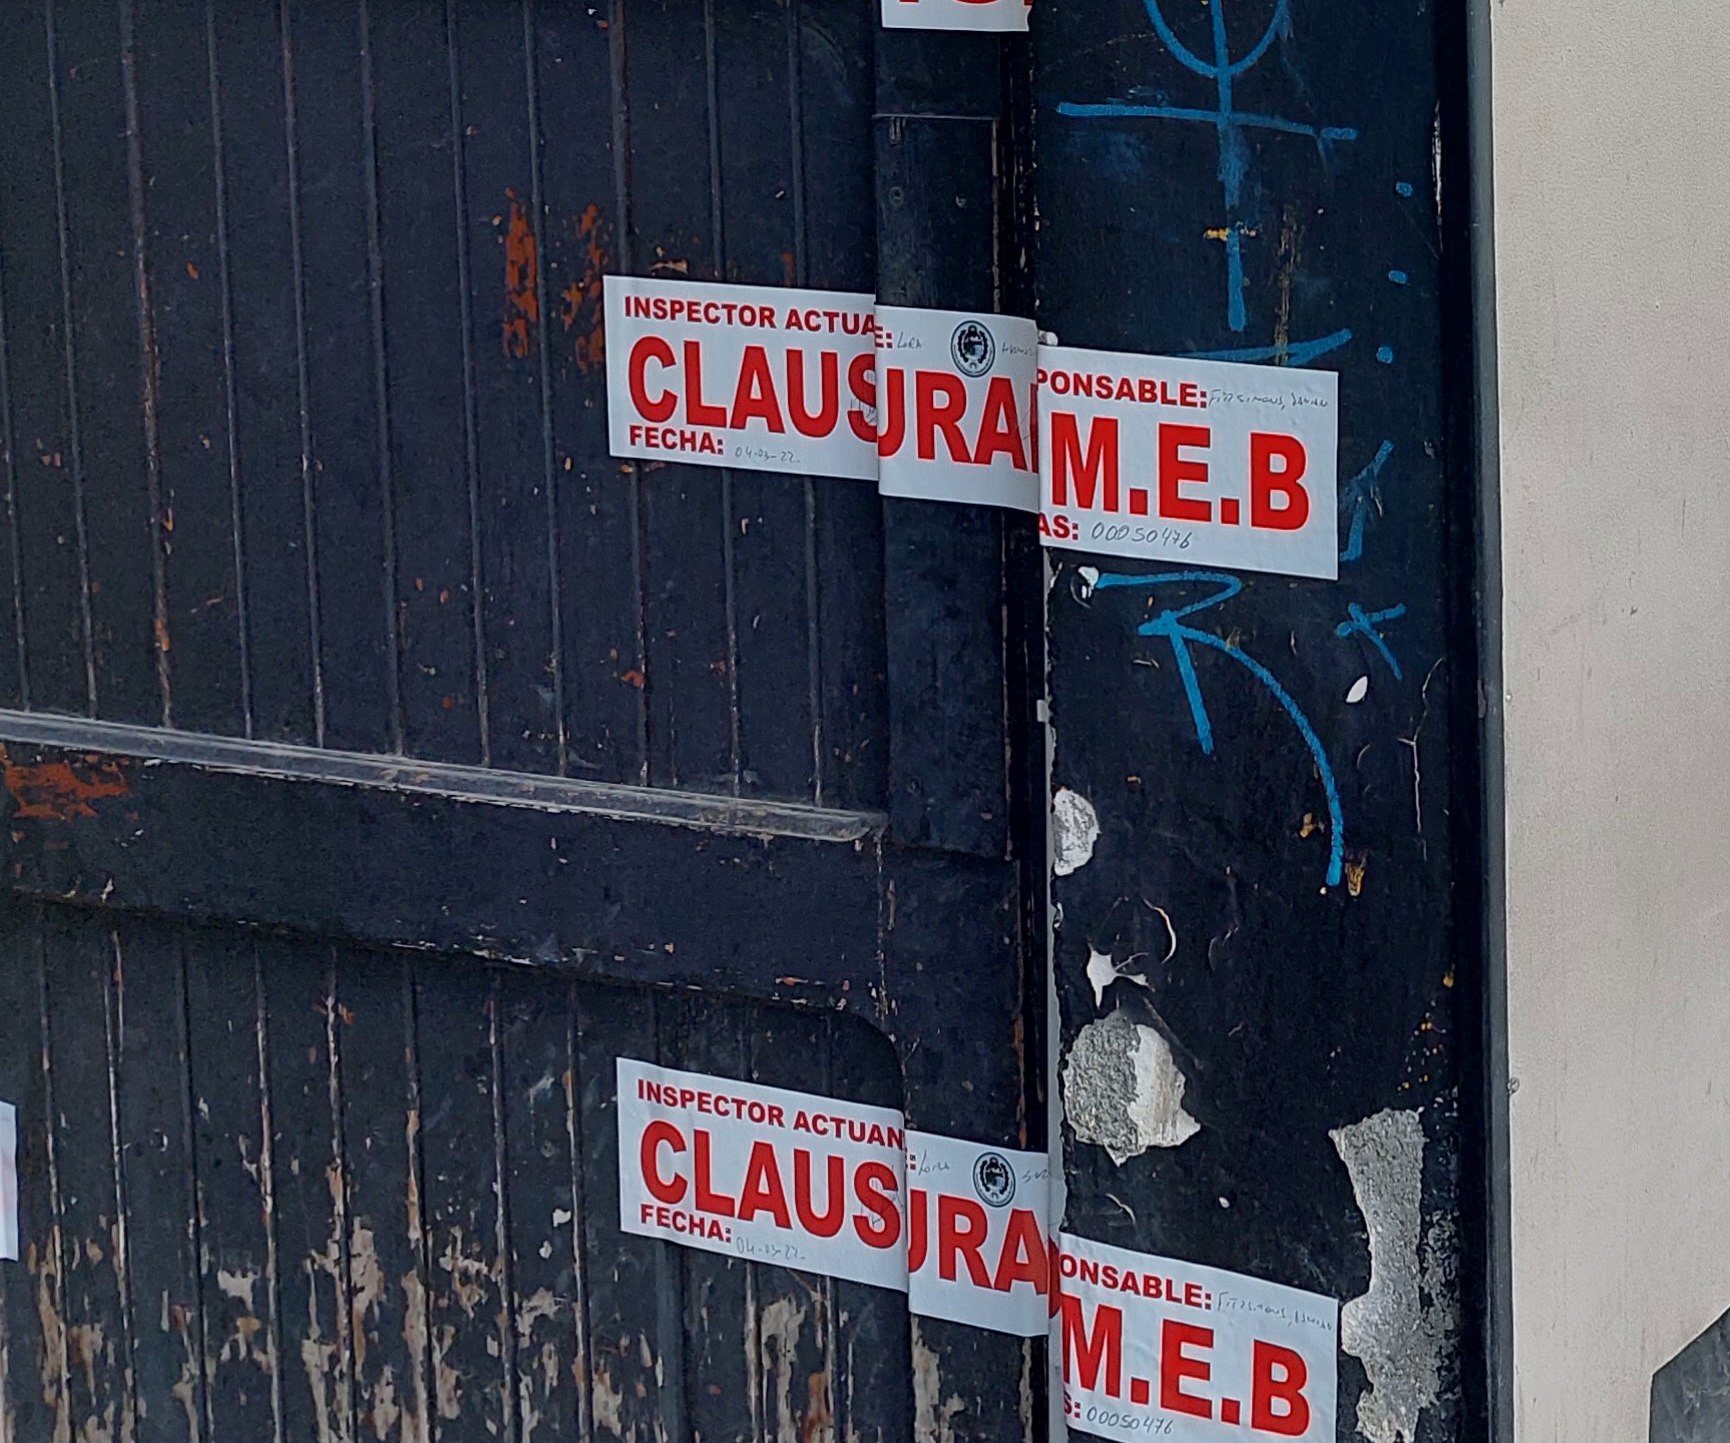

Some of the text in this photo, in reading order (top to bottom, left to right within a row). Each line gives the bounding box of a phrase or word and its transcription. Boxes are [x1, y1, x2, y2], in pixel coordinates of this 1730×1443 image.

[624, 295, 778, 329] INSPECTOR
[629, 424, 724, 456] FECHA:
[1049, 411, 1310, 533] M.E.B
[637, 1078, 786, 1129] INSPECTOR
[641, 1203, 732, 1244] FECHA:
[1061, 1291, 1311, 1439] M.E.B
